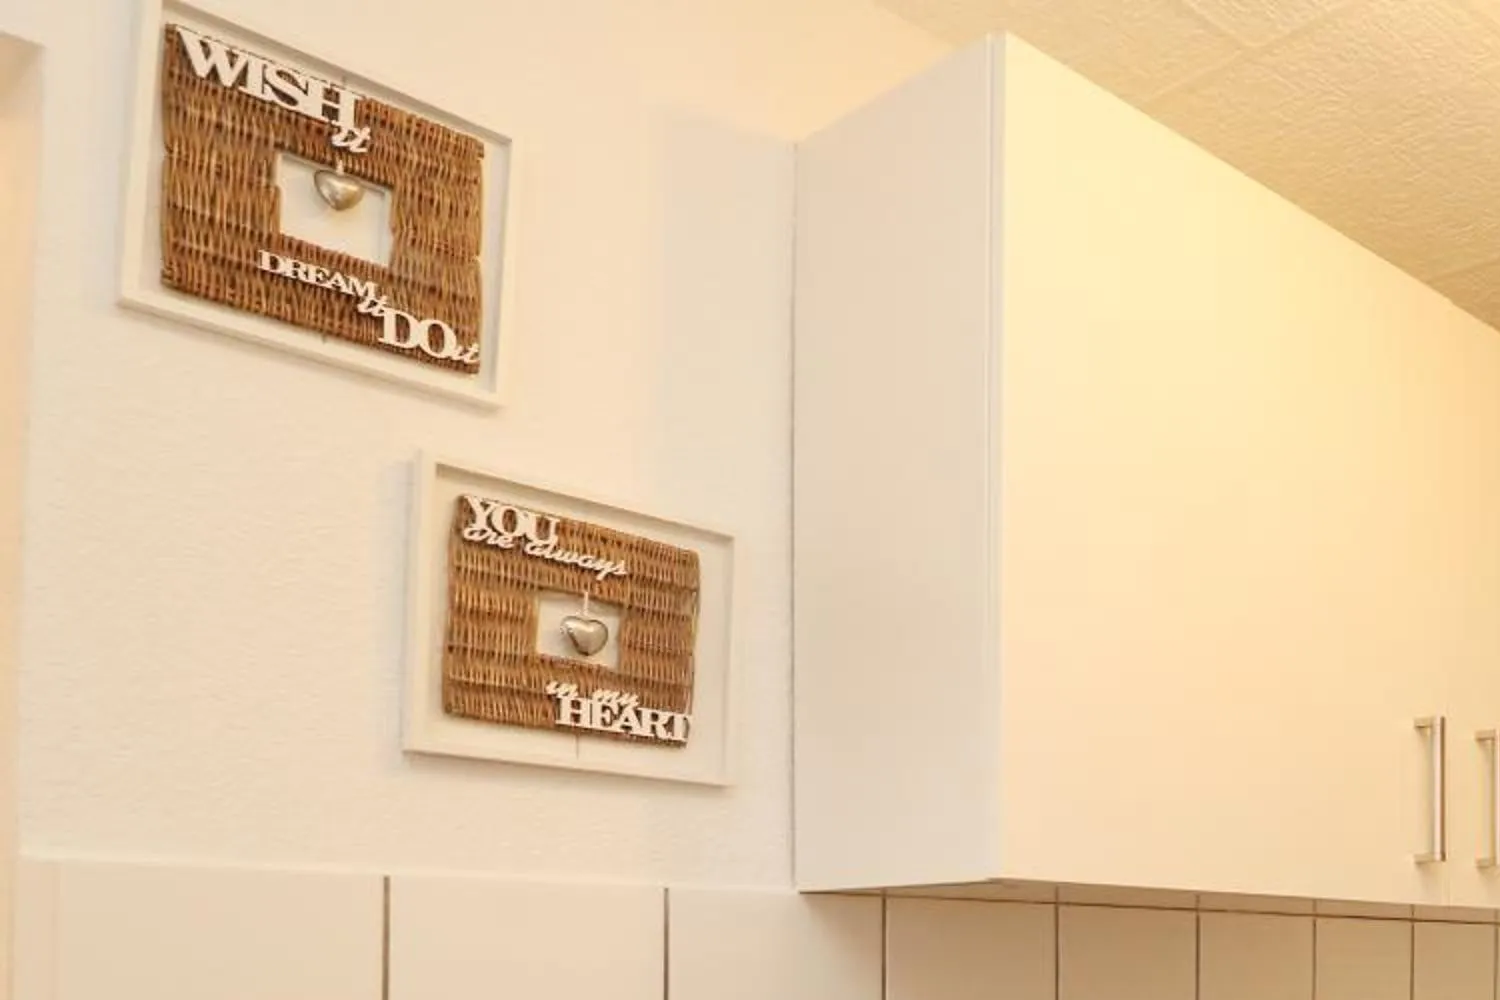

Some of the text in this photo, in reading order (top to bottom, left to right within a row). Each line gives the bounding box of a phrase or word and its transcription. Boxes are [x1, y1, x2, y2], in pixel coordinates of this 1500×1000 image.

[176, 25, 362, 129] WISH
[331, 122, 371, 153] it
[257, 249, 378, 300] DREAM
[357, 292, 389, 317] it
[378, 307, 480, 364] DO it
[464, 495, 560, 545] YOU
[463, 523, 629, 581] are always
[555, 696, 693, 743] HEART
